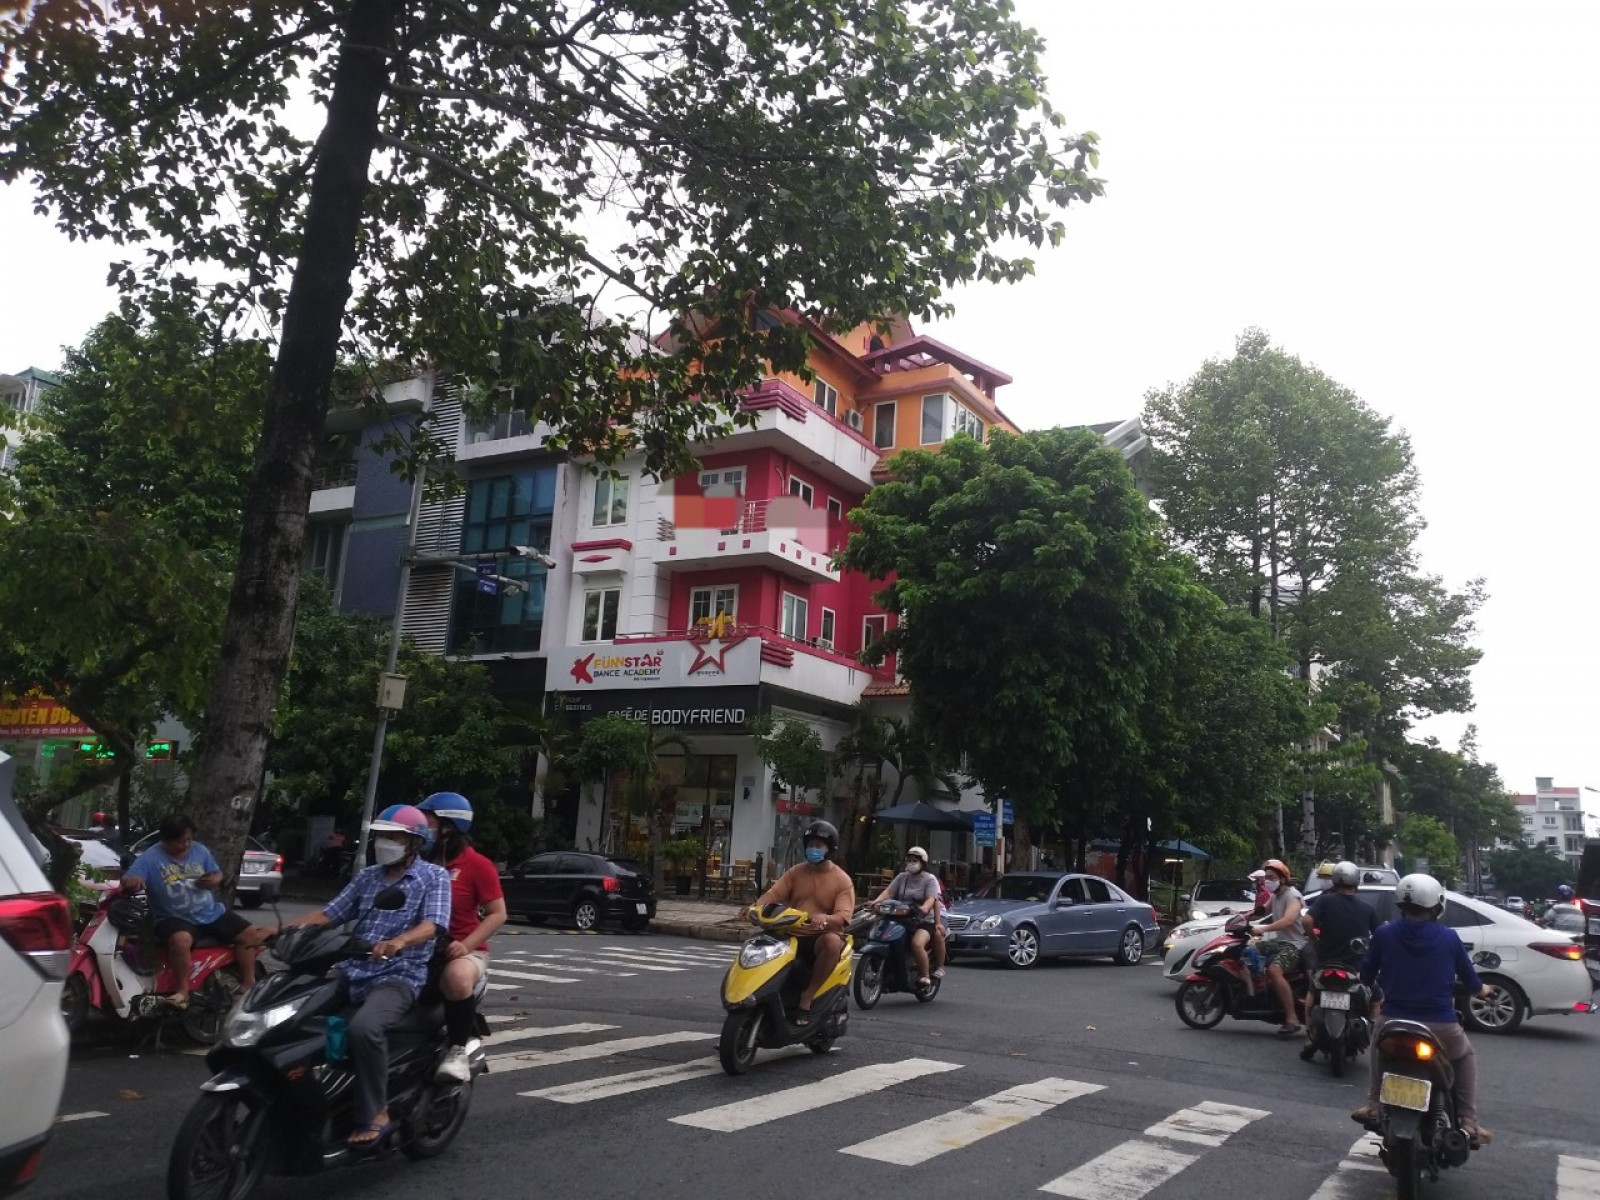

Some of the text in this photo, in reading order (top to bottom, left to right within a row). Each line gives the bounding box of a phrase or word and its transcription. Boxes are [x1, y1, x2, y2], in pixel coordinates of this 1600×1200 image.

[593, 668, 661, 678] DANCE ACADEMY
[634, 709, 648, 721] DE
[651, 708, 745, 725] BODYFRIEND
